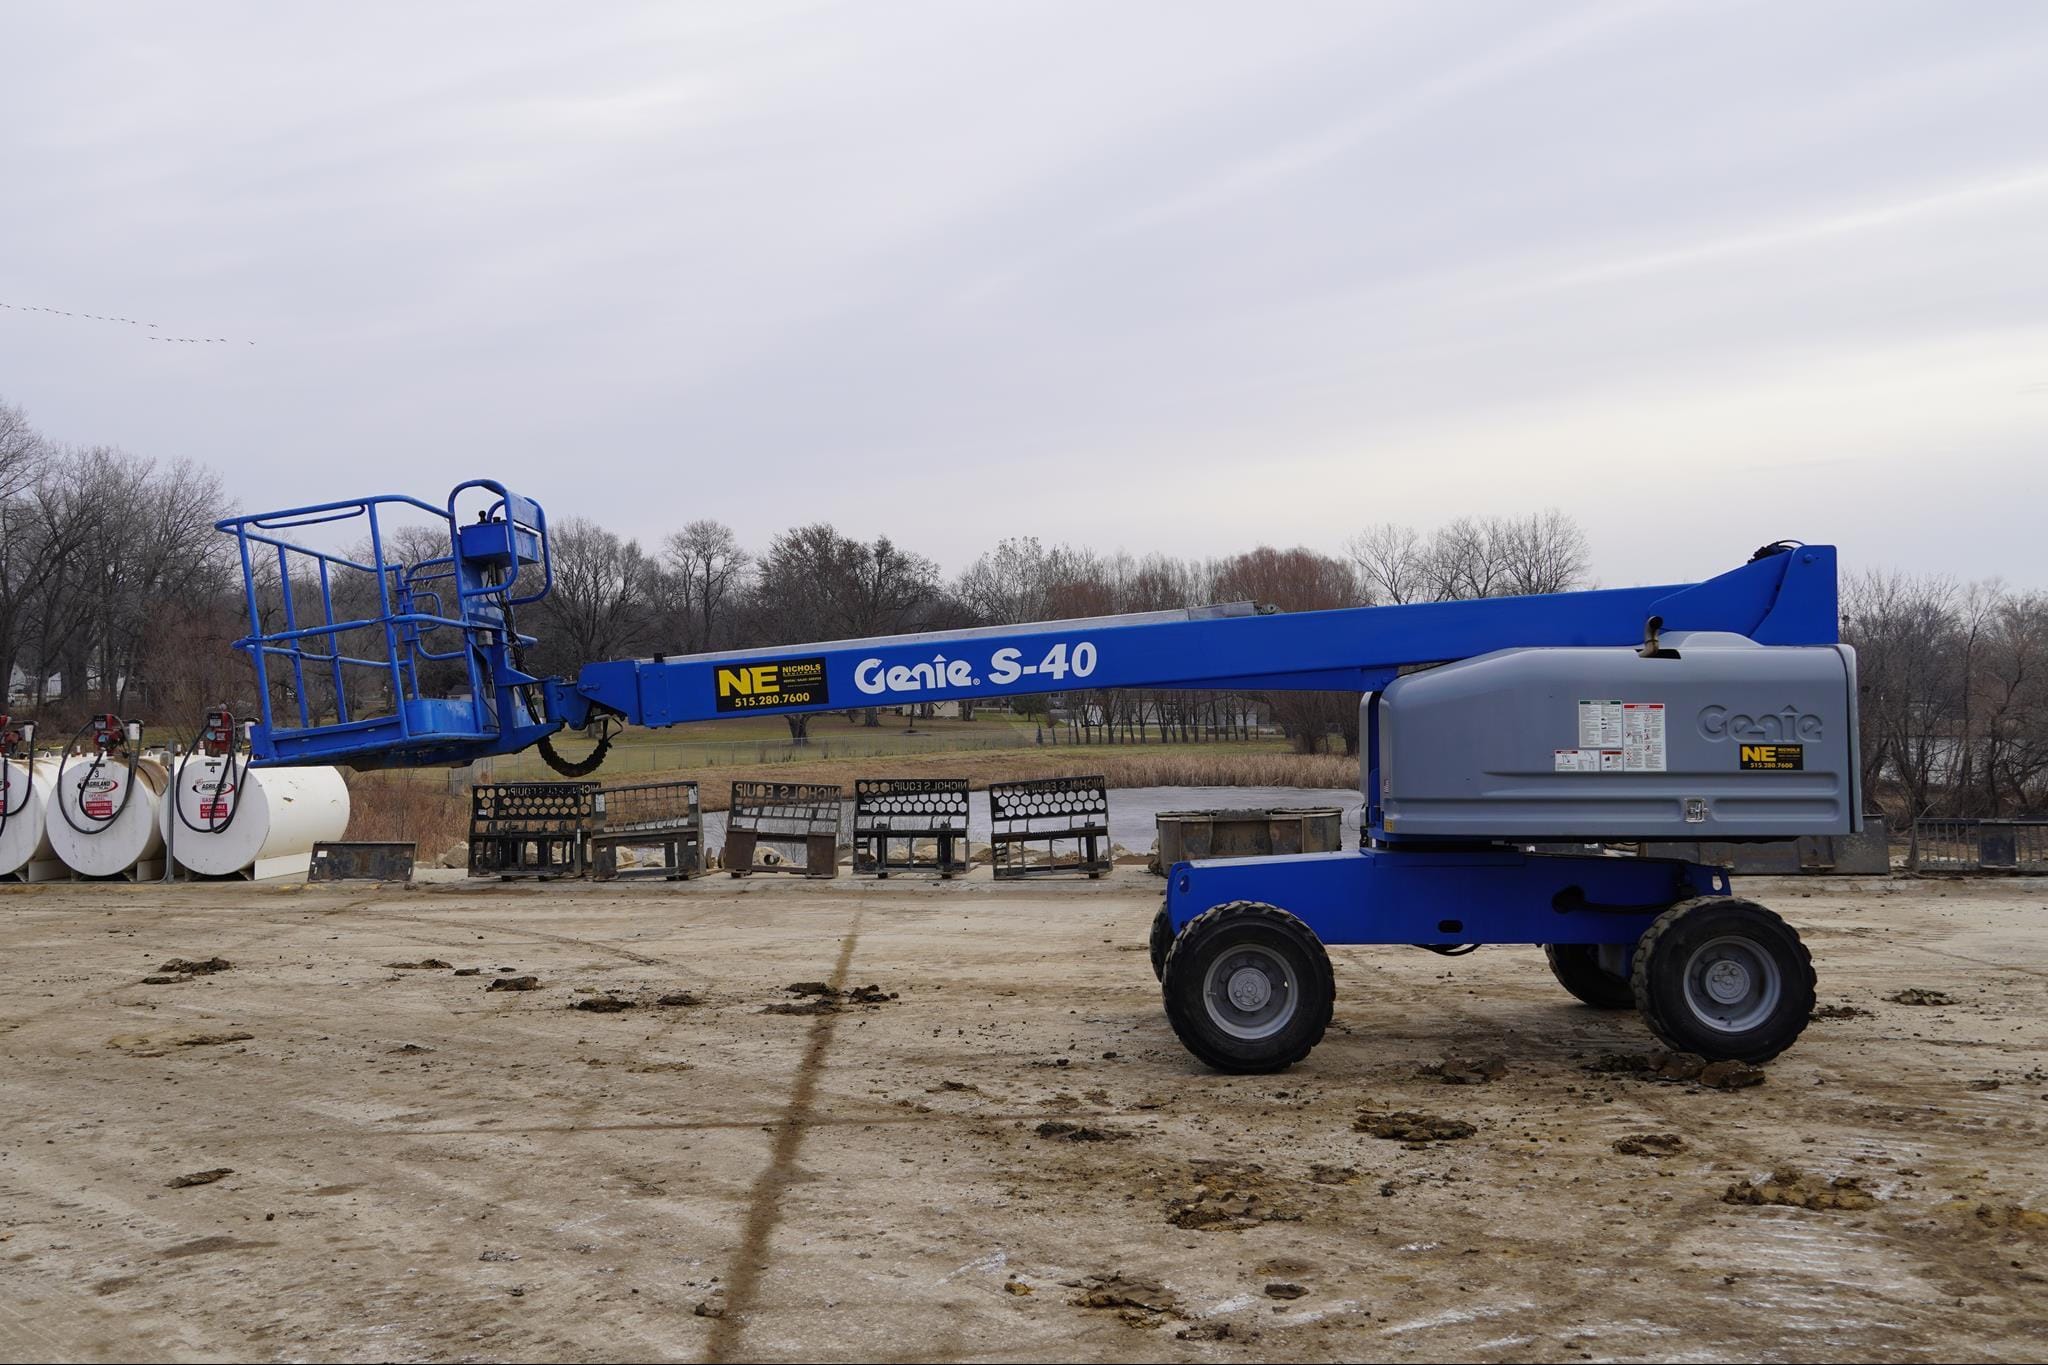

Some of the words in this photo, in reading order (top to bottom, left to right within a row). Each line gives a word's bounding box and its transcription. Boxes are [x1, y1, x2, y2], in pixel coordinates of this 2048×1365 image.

[782, 663, 821, 673] NICHOLS
[854, 654, 972, 694] Genie
[988, 641, 1097, 685] S-40
[718, 665, 780, 697] NE
[735, 692, 810, 708] 515.280.7600
[1696, 704, 1823, 743] Genie
[1742, 746, 1777, 762] NE
[94, 770, 100, 778] 3
[210, 766, 215, 774] 4
